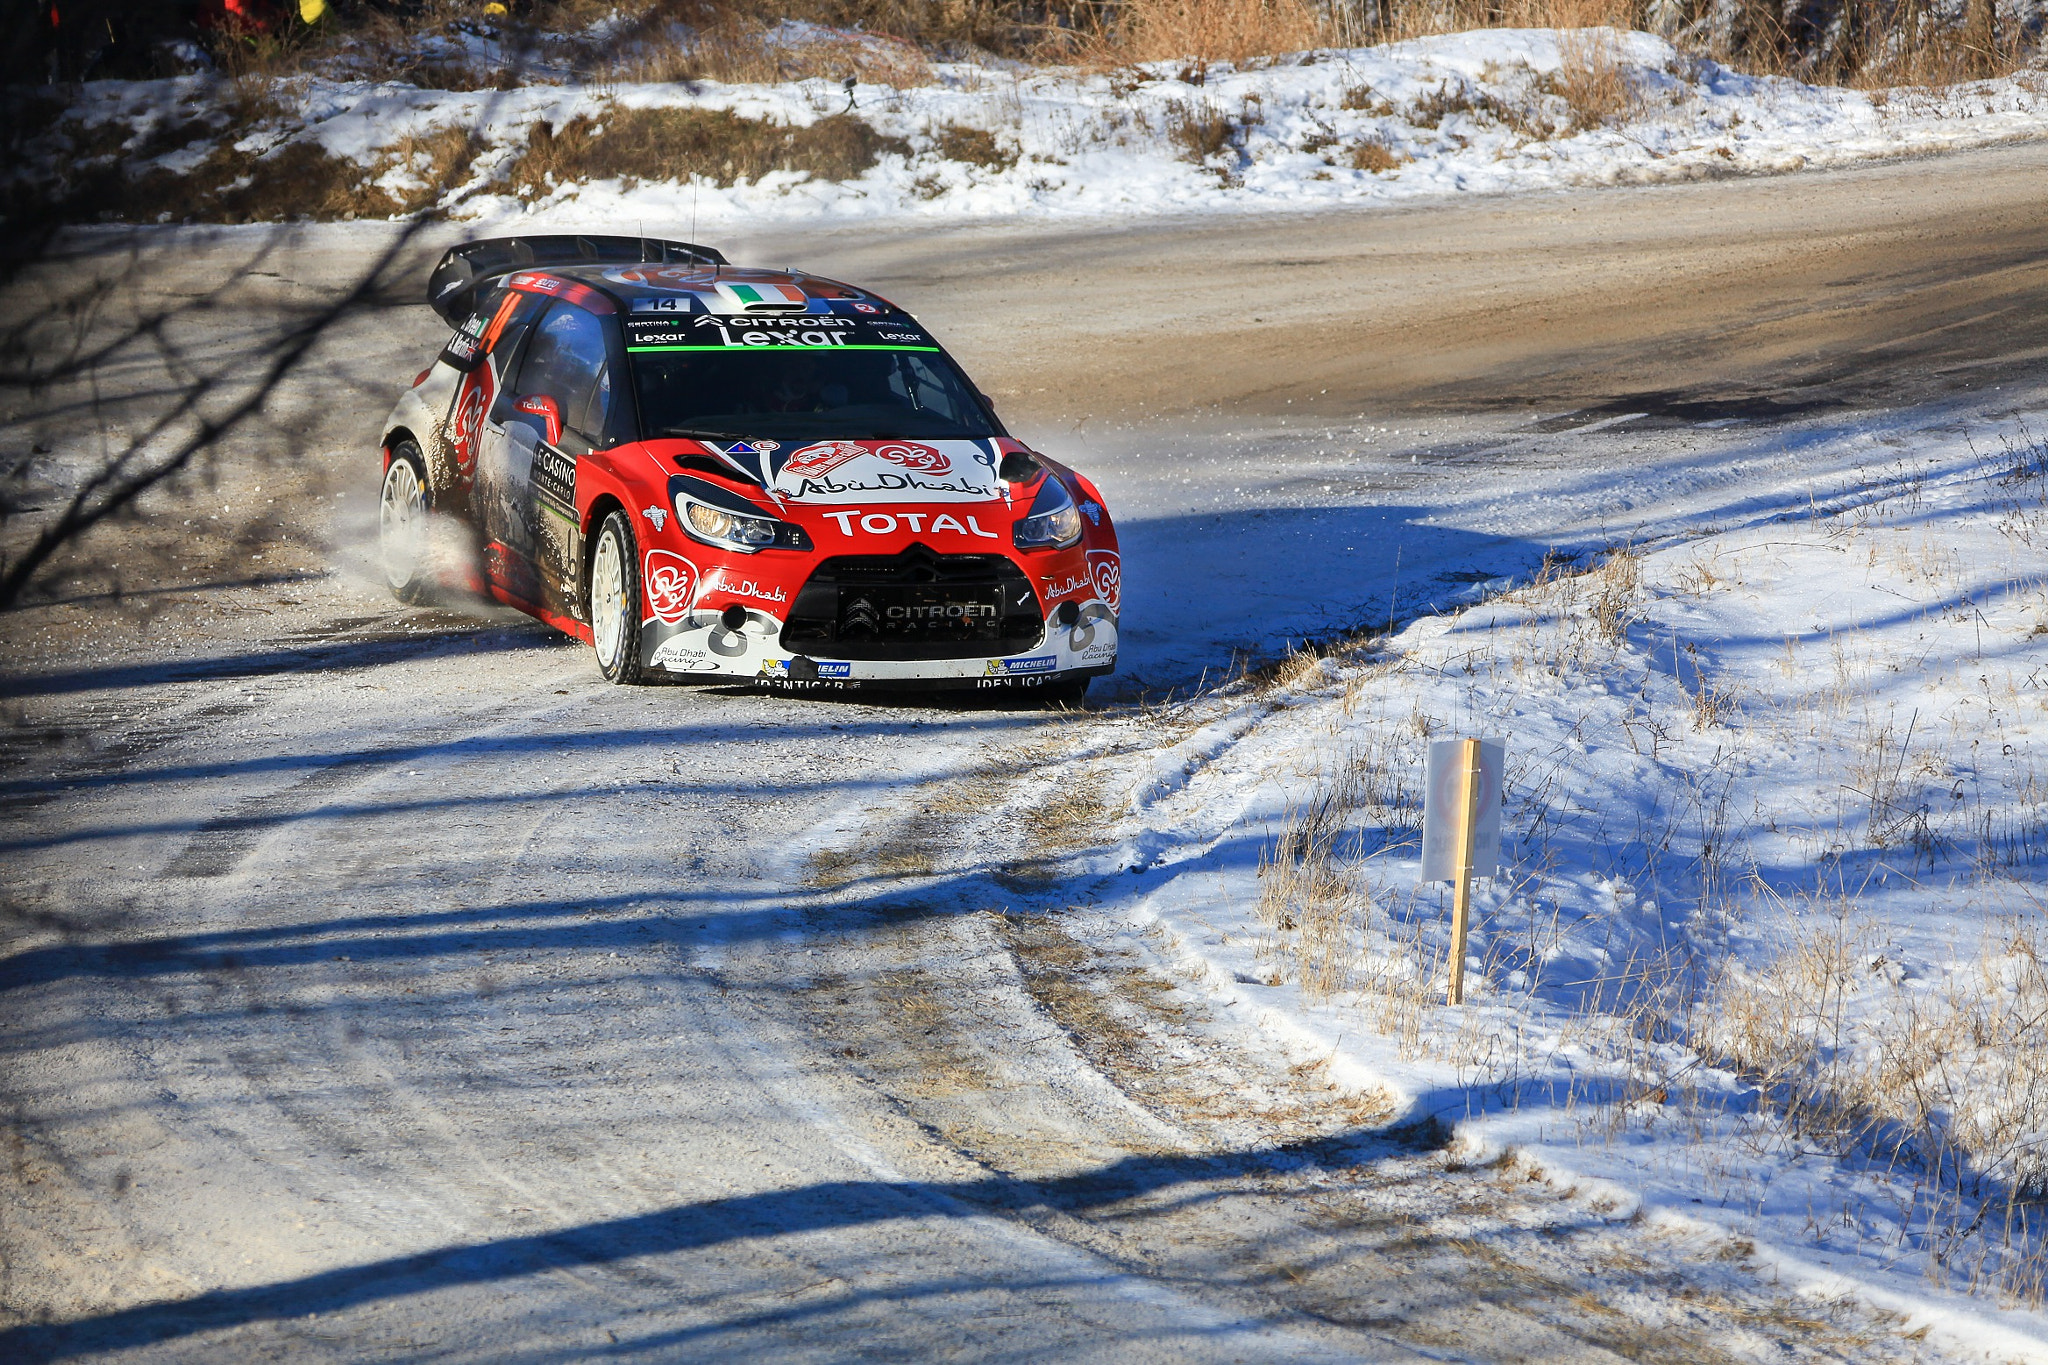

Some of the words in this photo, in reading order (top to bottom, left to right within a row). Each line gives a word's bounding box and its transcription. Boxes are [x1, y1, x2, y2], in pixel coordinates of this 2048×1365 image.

[647, 298, 677, 310] 14
[729, 316, 856, 327] CITROËN
[635, 333, 686, 342] Lexar
[719, 326, 848, 346] Lexar
[878, 331, 921, 341] Lexar
[543, 453, 576, 487] CASINO
[822, 510, 999, 539] TOTAL
[885, 600, 998, 619] CITROËN
[886, 620, 996, 629] RACING
[661, 646, 678, 656] Abu
[680, 648, 708, 658] Dhabi
[654, 651, 703, 669] Racing
[1010, 658, 1056, 669] MICHELIN
